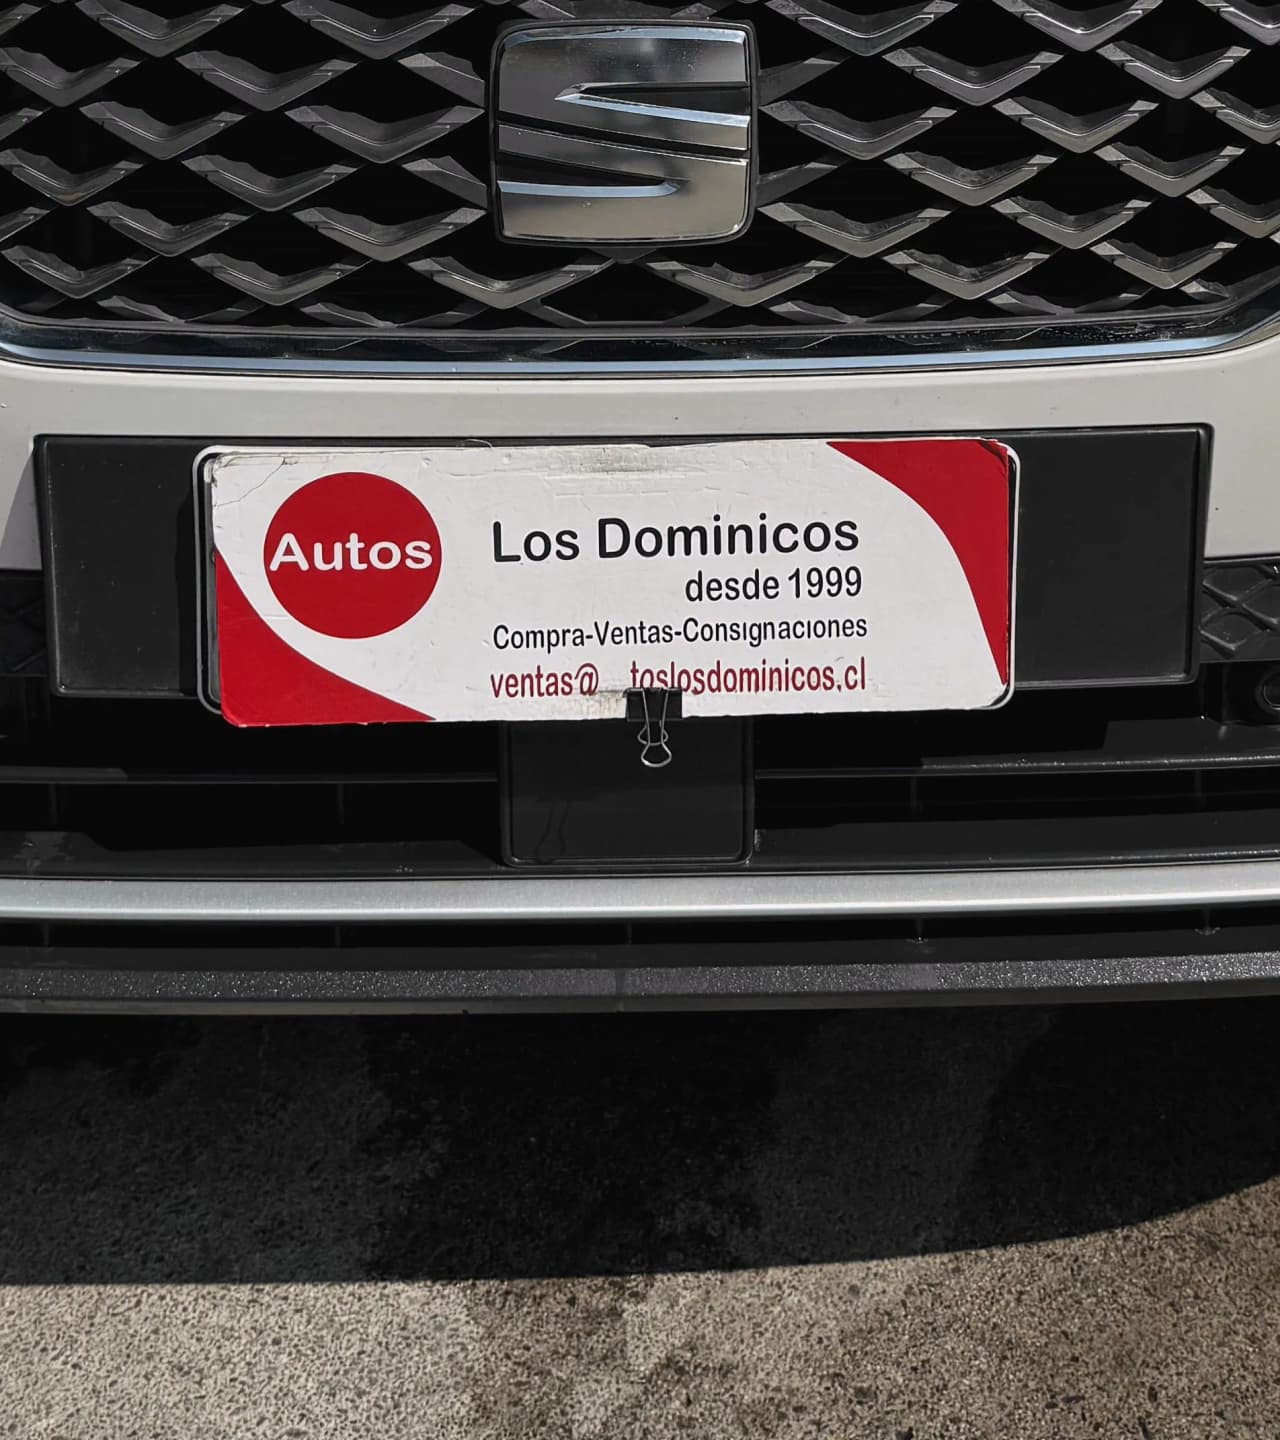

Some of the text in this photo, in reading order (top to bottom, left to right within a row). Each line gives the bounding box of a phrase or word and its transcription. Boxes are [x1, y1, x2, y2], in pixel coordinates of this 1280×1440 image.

[268, 531, 434, 572] Autos
[492, 513, 859, 563] Los Dominicos
[684, 566, 863, 602] desde 1999
[492, 616, 869, 655] Compra-Ventas-Consignaciones
